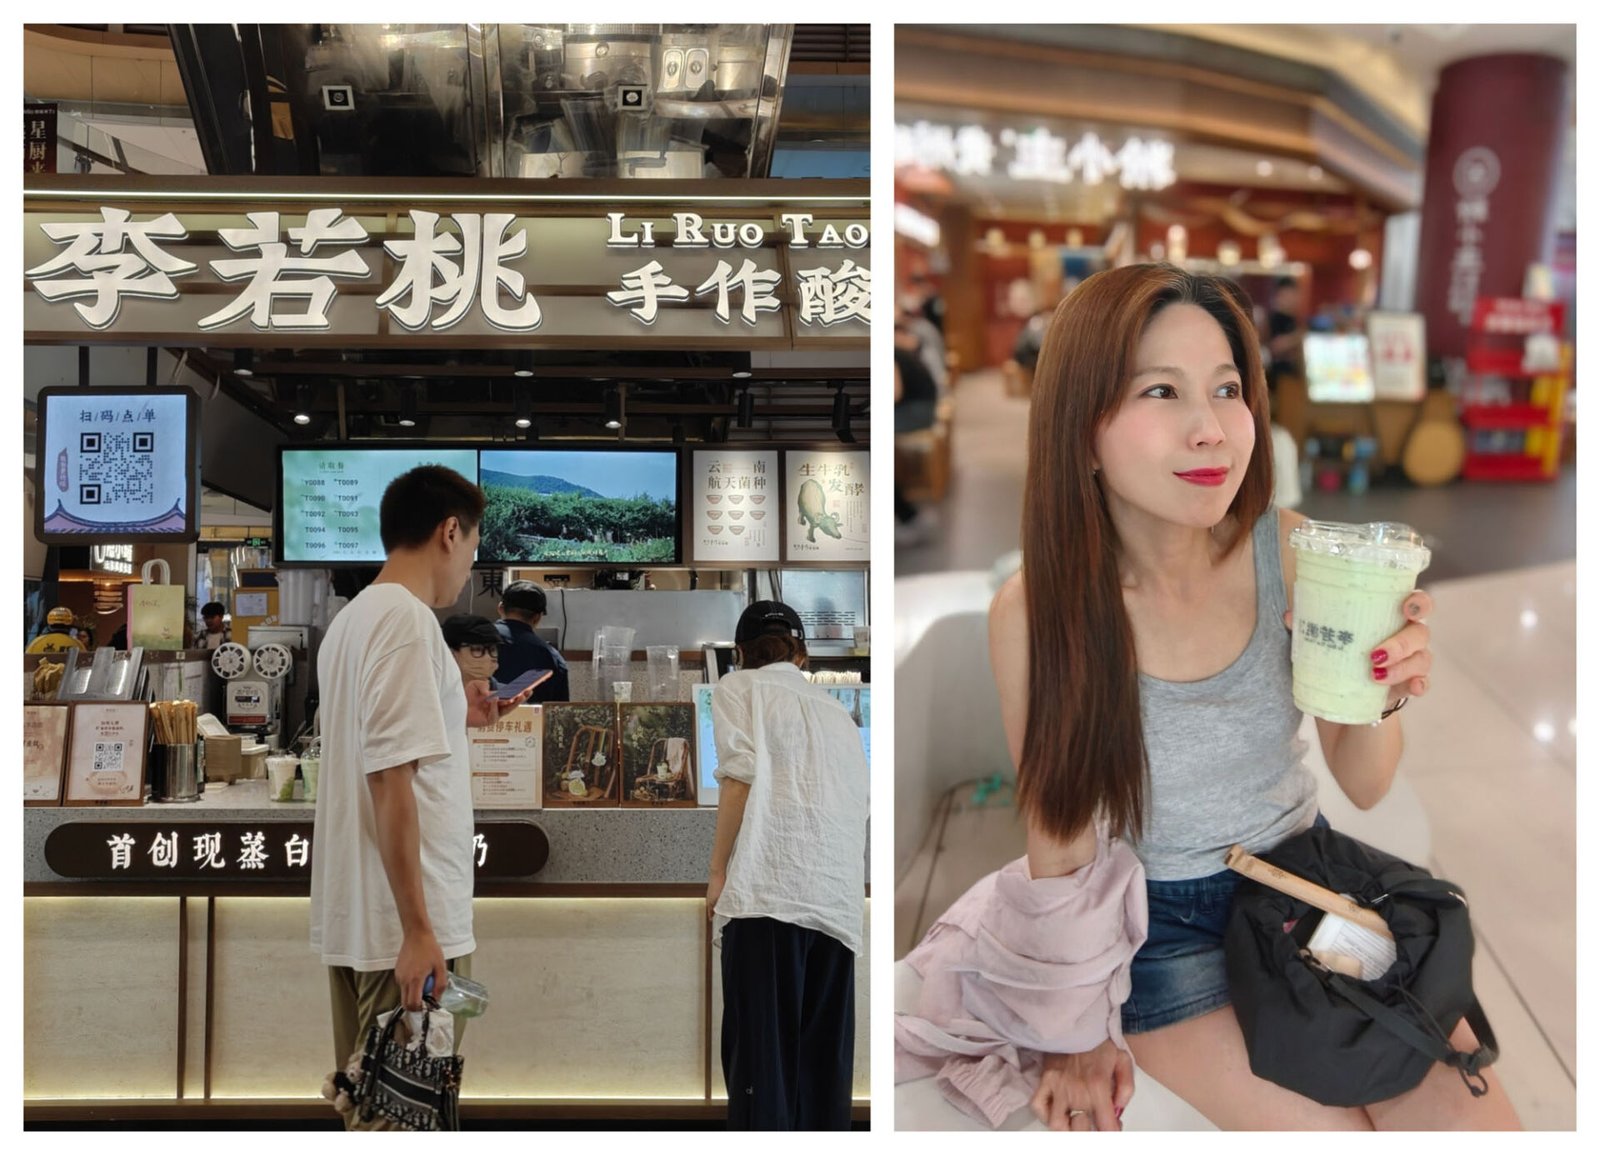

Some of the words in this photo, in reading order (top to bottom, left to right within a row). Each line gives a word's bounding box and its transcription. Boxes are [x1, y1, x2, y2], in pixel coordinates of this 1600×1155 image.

[673, 212, 764, 248] RUO
[781, 213, 869, 249] TAO
[25, 206, 543, 332] 李若桃
[606, 258, 871, 328] 手作酸
[708, 475, 767, 490] 航天菌种
[106, 831, 310, 870] 首创现蒸白
